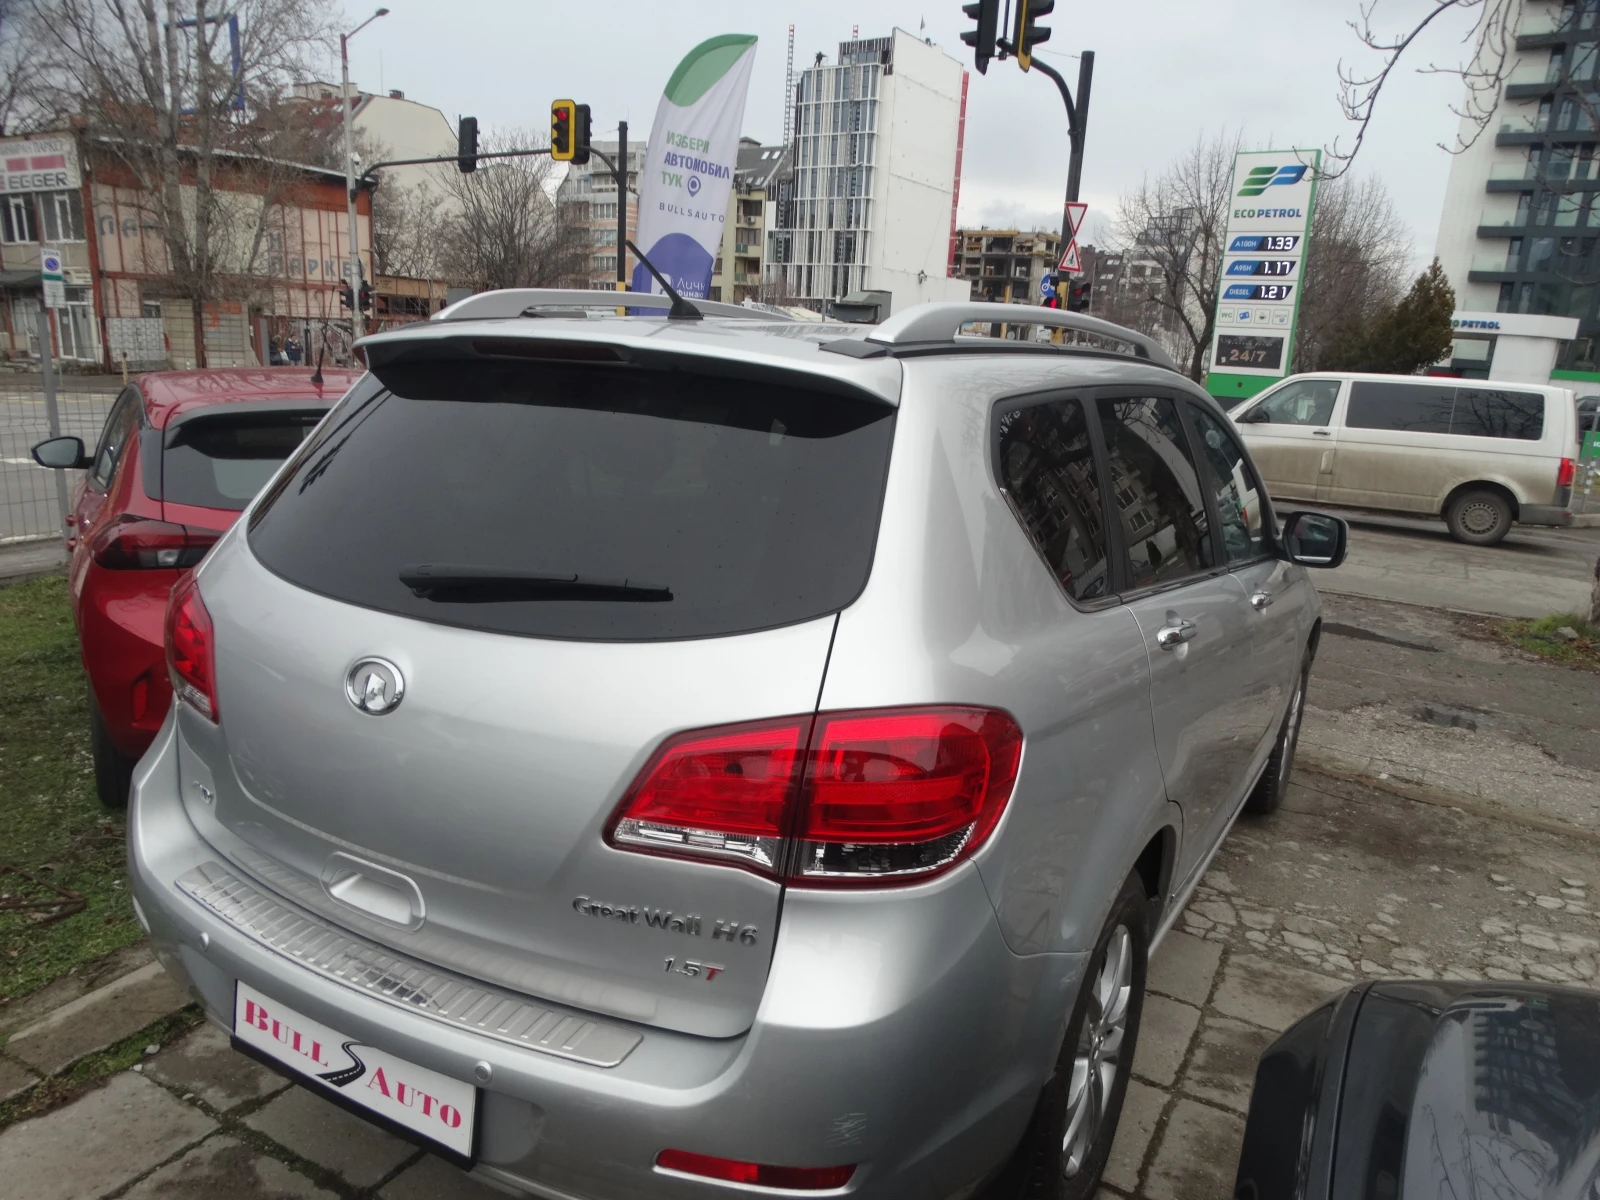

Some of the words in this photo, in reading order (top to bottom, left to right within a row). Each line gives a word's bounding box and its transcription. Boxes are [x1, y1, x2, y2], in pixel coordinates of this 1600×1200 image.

[666, 131, 710, 154] ИЗБЕРИ
[664, 151, 730, 179] АВТОМОБИЛ
[8, 171, 68, 190] EGGER
[661, 170, 683, 188] ТУК
[659, 202, 725, 223] BULLSAUTO
[1234, 209, 1256, 219] ECO
[1256, 208, 1302, 219] PETROL
[1267, 236, 1294, 250] 1.33
[1264, 261, 1291, 274] 1.17
[1260, 285, 1287, 298] 1.21
[1460, 320, 1501, 329] PETROL
[1229, 348, 1267, 362] 24/7
[572, 895, 641, 926] Great
[643, 907, 702, 937] Wall
[711, 919, 759, 947] H6
[664, 954, 726, 981] 1.5T
[243, 999, 329, 1068] BULL
[365, 1066, 462, 1129] AUTO
